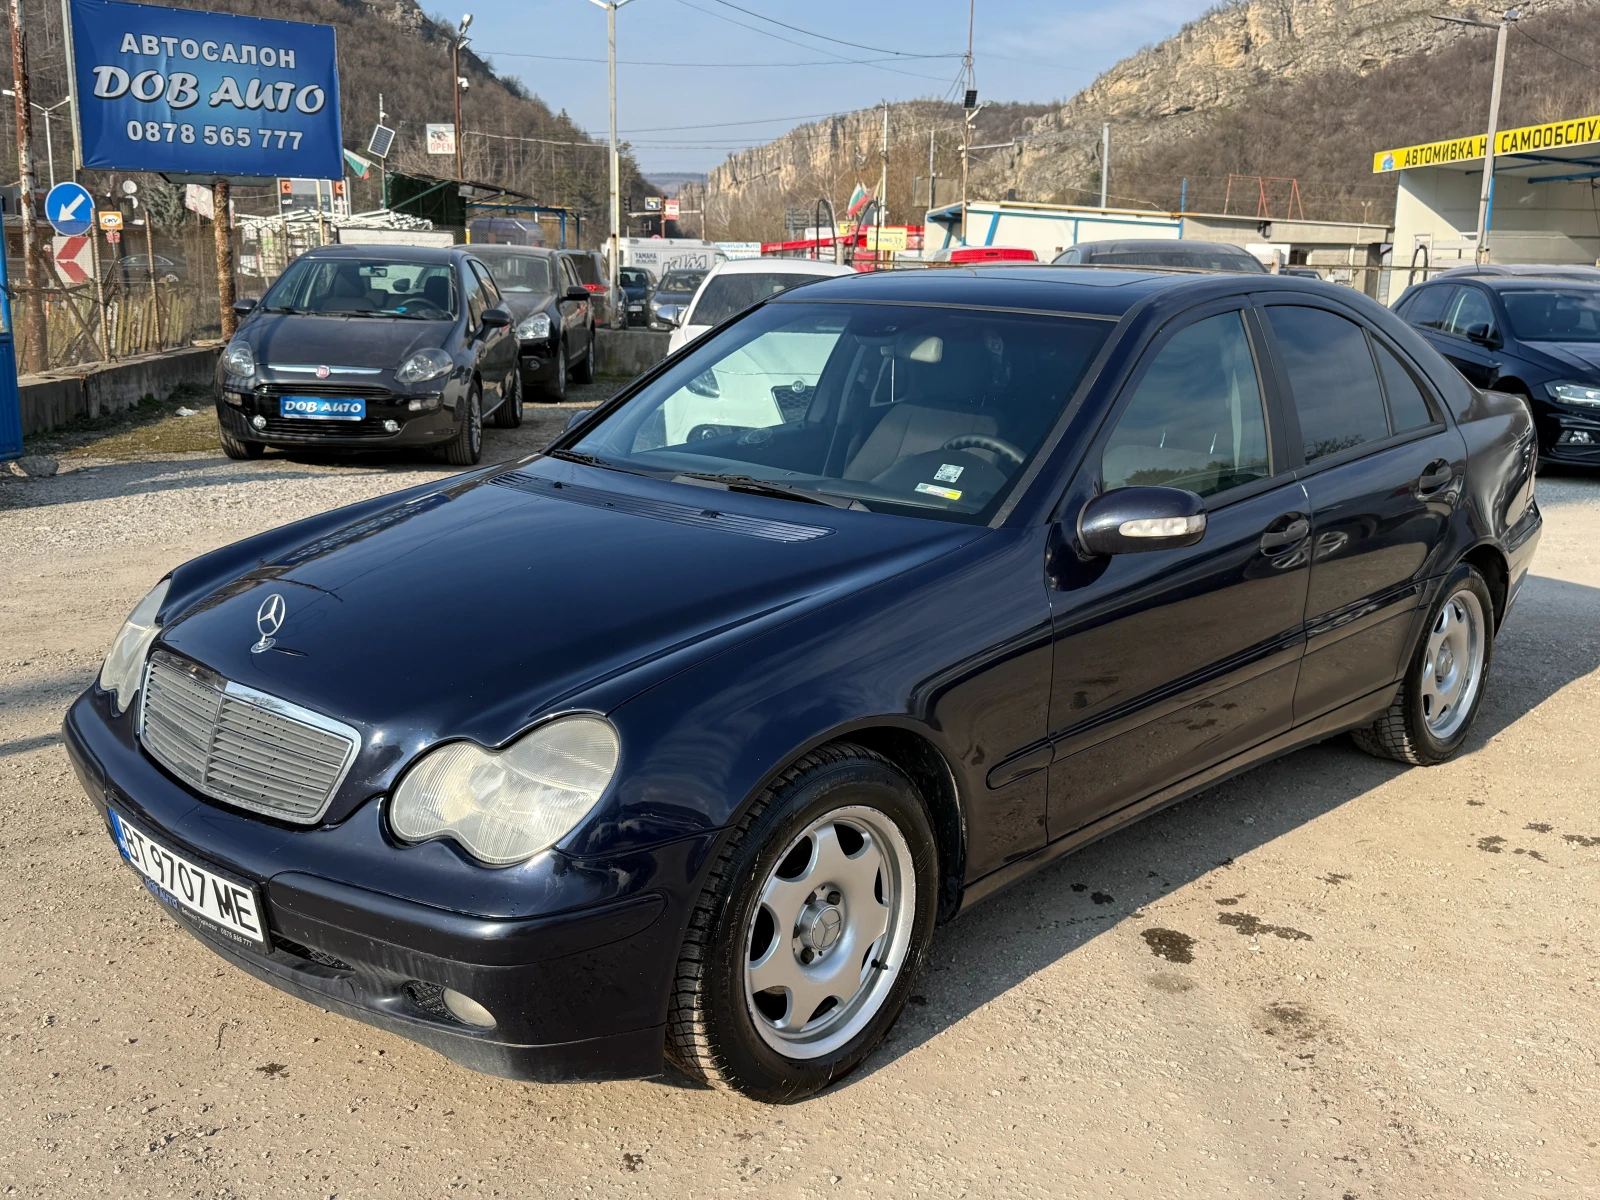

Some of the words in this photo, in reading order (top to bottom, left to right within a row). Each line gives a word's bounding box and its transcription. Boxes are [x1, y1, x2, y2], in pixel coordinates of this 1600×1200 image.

[120, 33, 296, 69] АВТОСАЛОН
[92, 65, 199, 109] DOB
[208, 77, 325, 114] AUTO
[126, 120, 196, 144] 0878
[203, 122, 252, 148] 565
[258, 128, 304, 150] 777
[430, 142, 453, 152] OPEN
[1404, 139, 1474, 167] АВТОМИВКА
[284, 400, 318, 413] DOB
[320, 402, 362, 413] AUTO
[120, 820, 149, 872] BT
[150, 844, 206, 908] 9707
[211, 878, 259, 934] ME
[159, 888, 179, 909] AUTO
